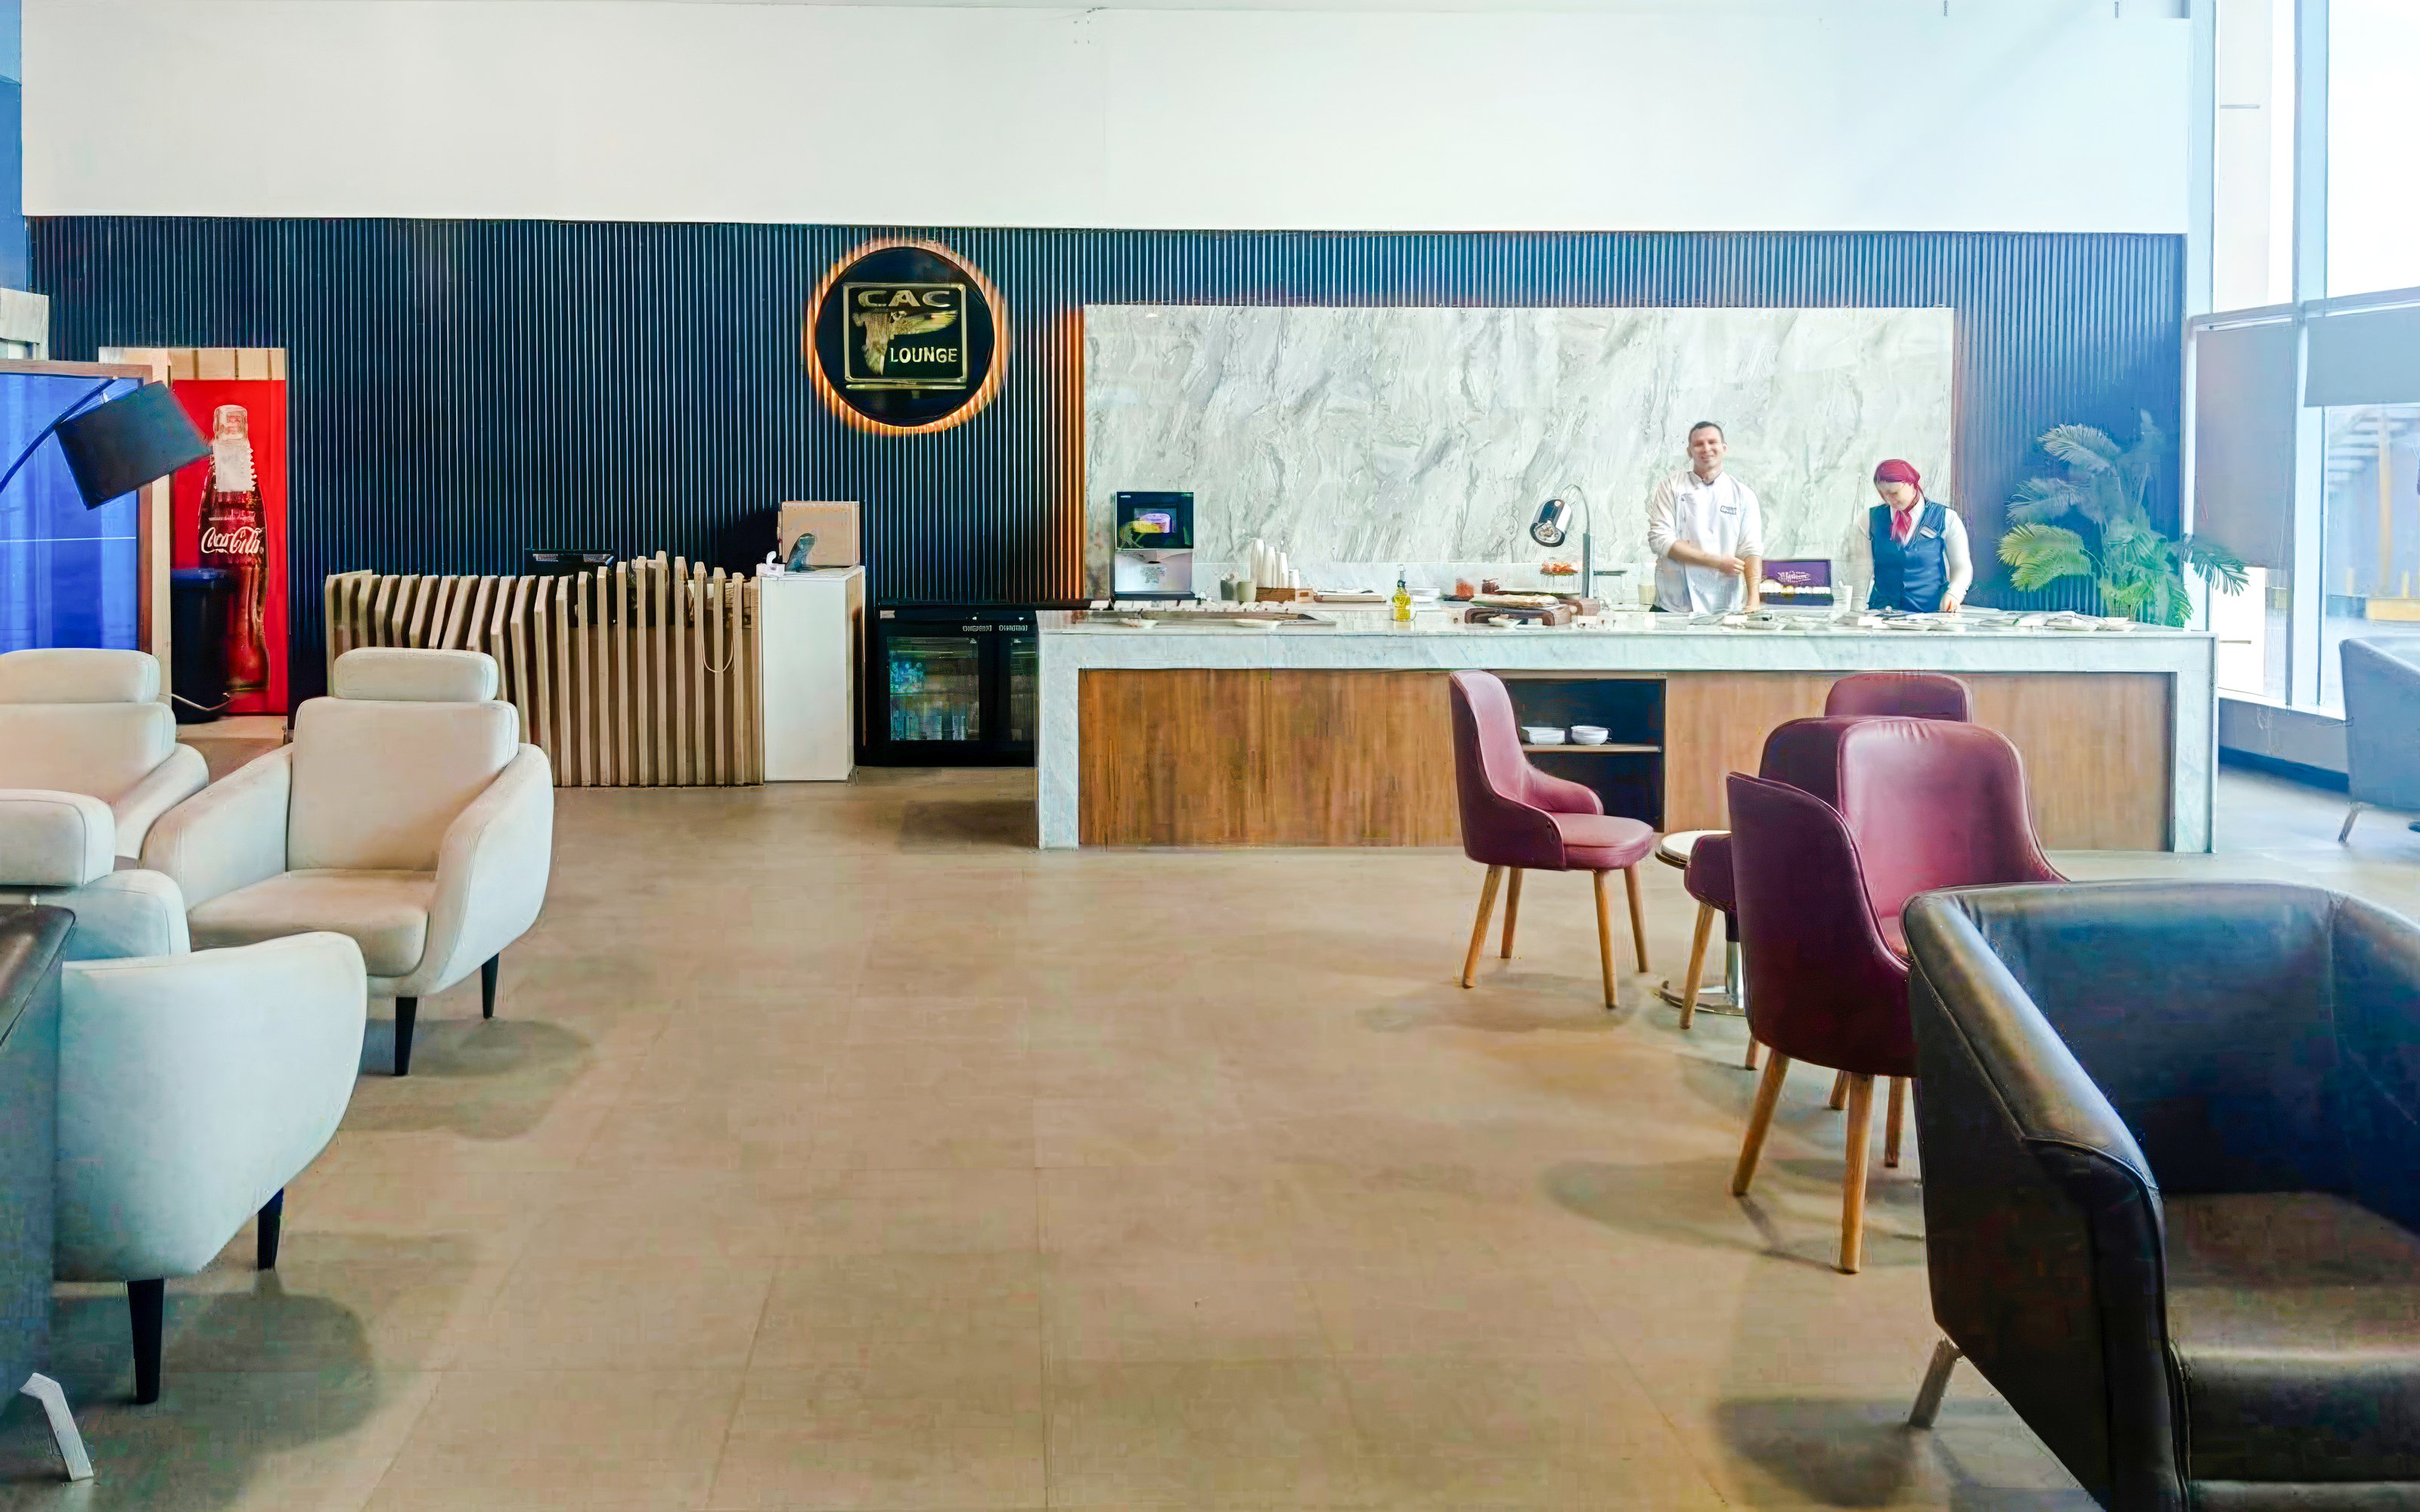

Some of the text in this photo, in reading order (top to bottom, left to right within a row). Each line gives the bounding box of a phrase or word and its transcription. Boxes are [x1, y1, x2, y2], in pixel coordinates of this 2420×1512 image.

[858, 290, 951, 308] CAC
[890, 346, 958, 364] LOUNGE
[201, 526, 262, 554] Coca-Cola
